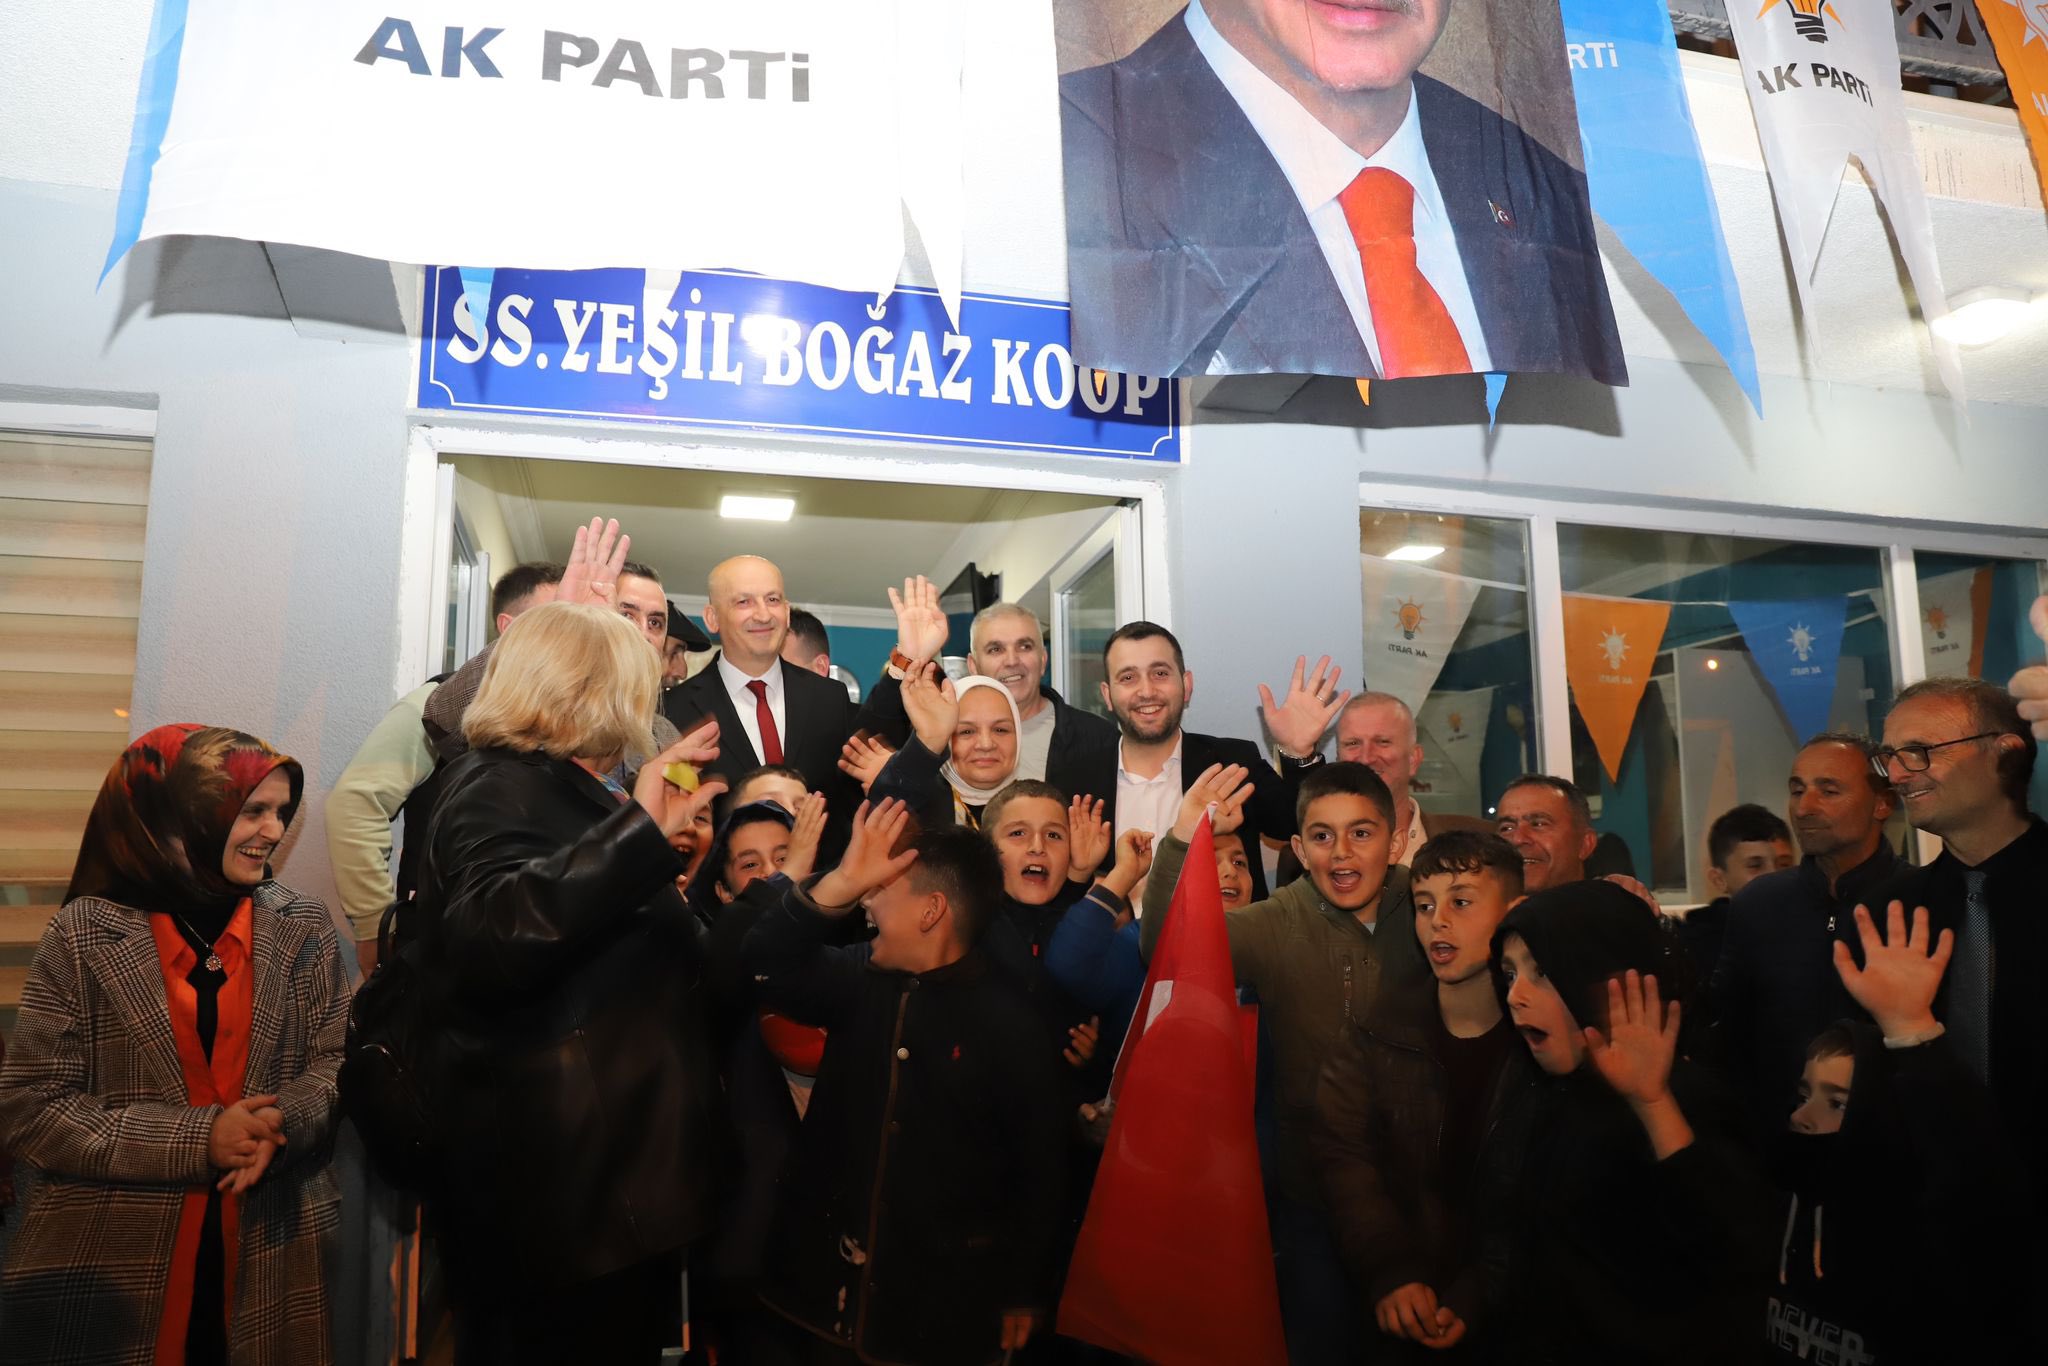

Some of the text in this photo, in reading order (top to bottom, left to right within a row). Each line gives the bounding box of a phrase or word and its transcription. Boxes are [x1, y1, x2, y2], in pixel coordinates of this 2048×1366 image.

[353, 16, 506, 79] AK
[761, 302, 973, 404] BOĞAZ
[990, 337, 1160, 416] KOOP
